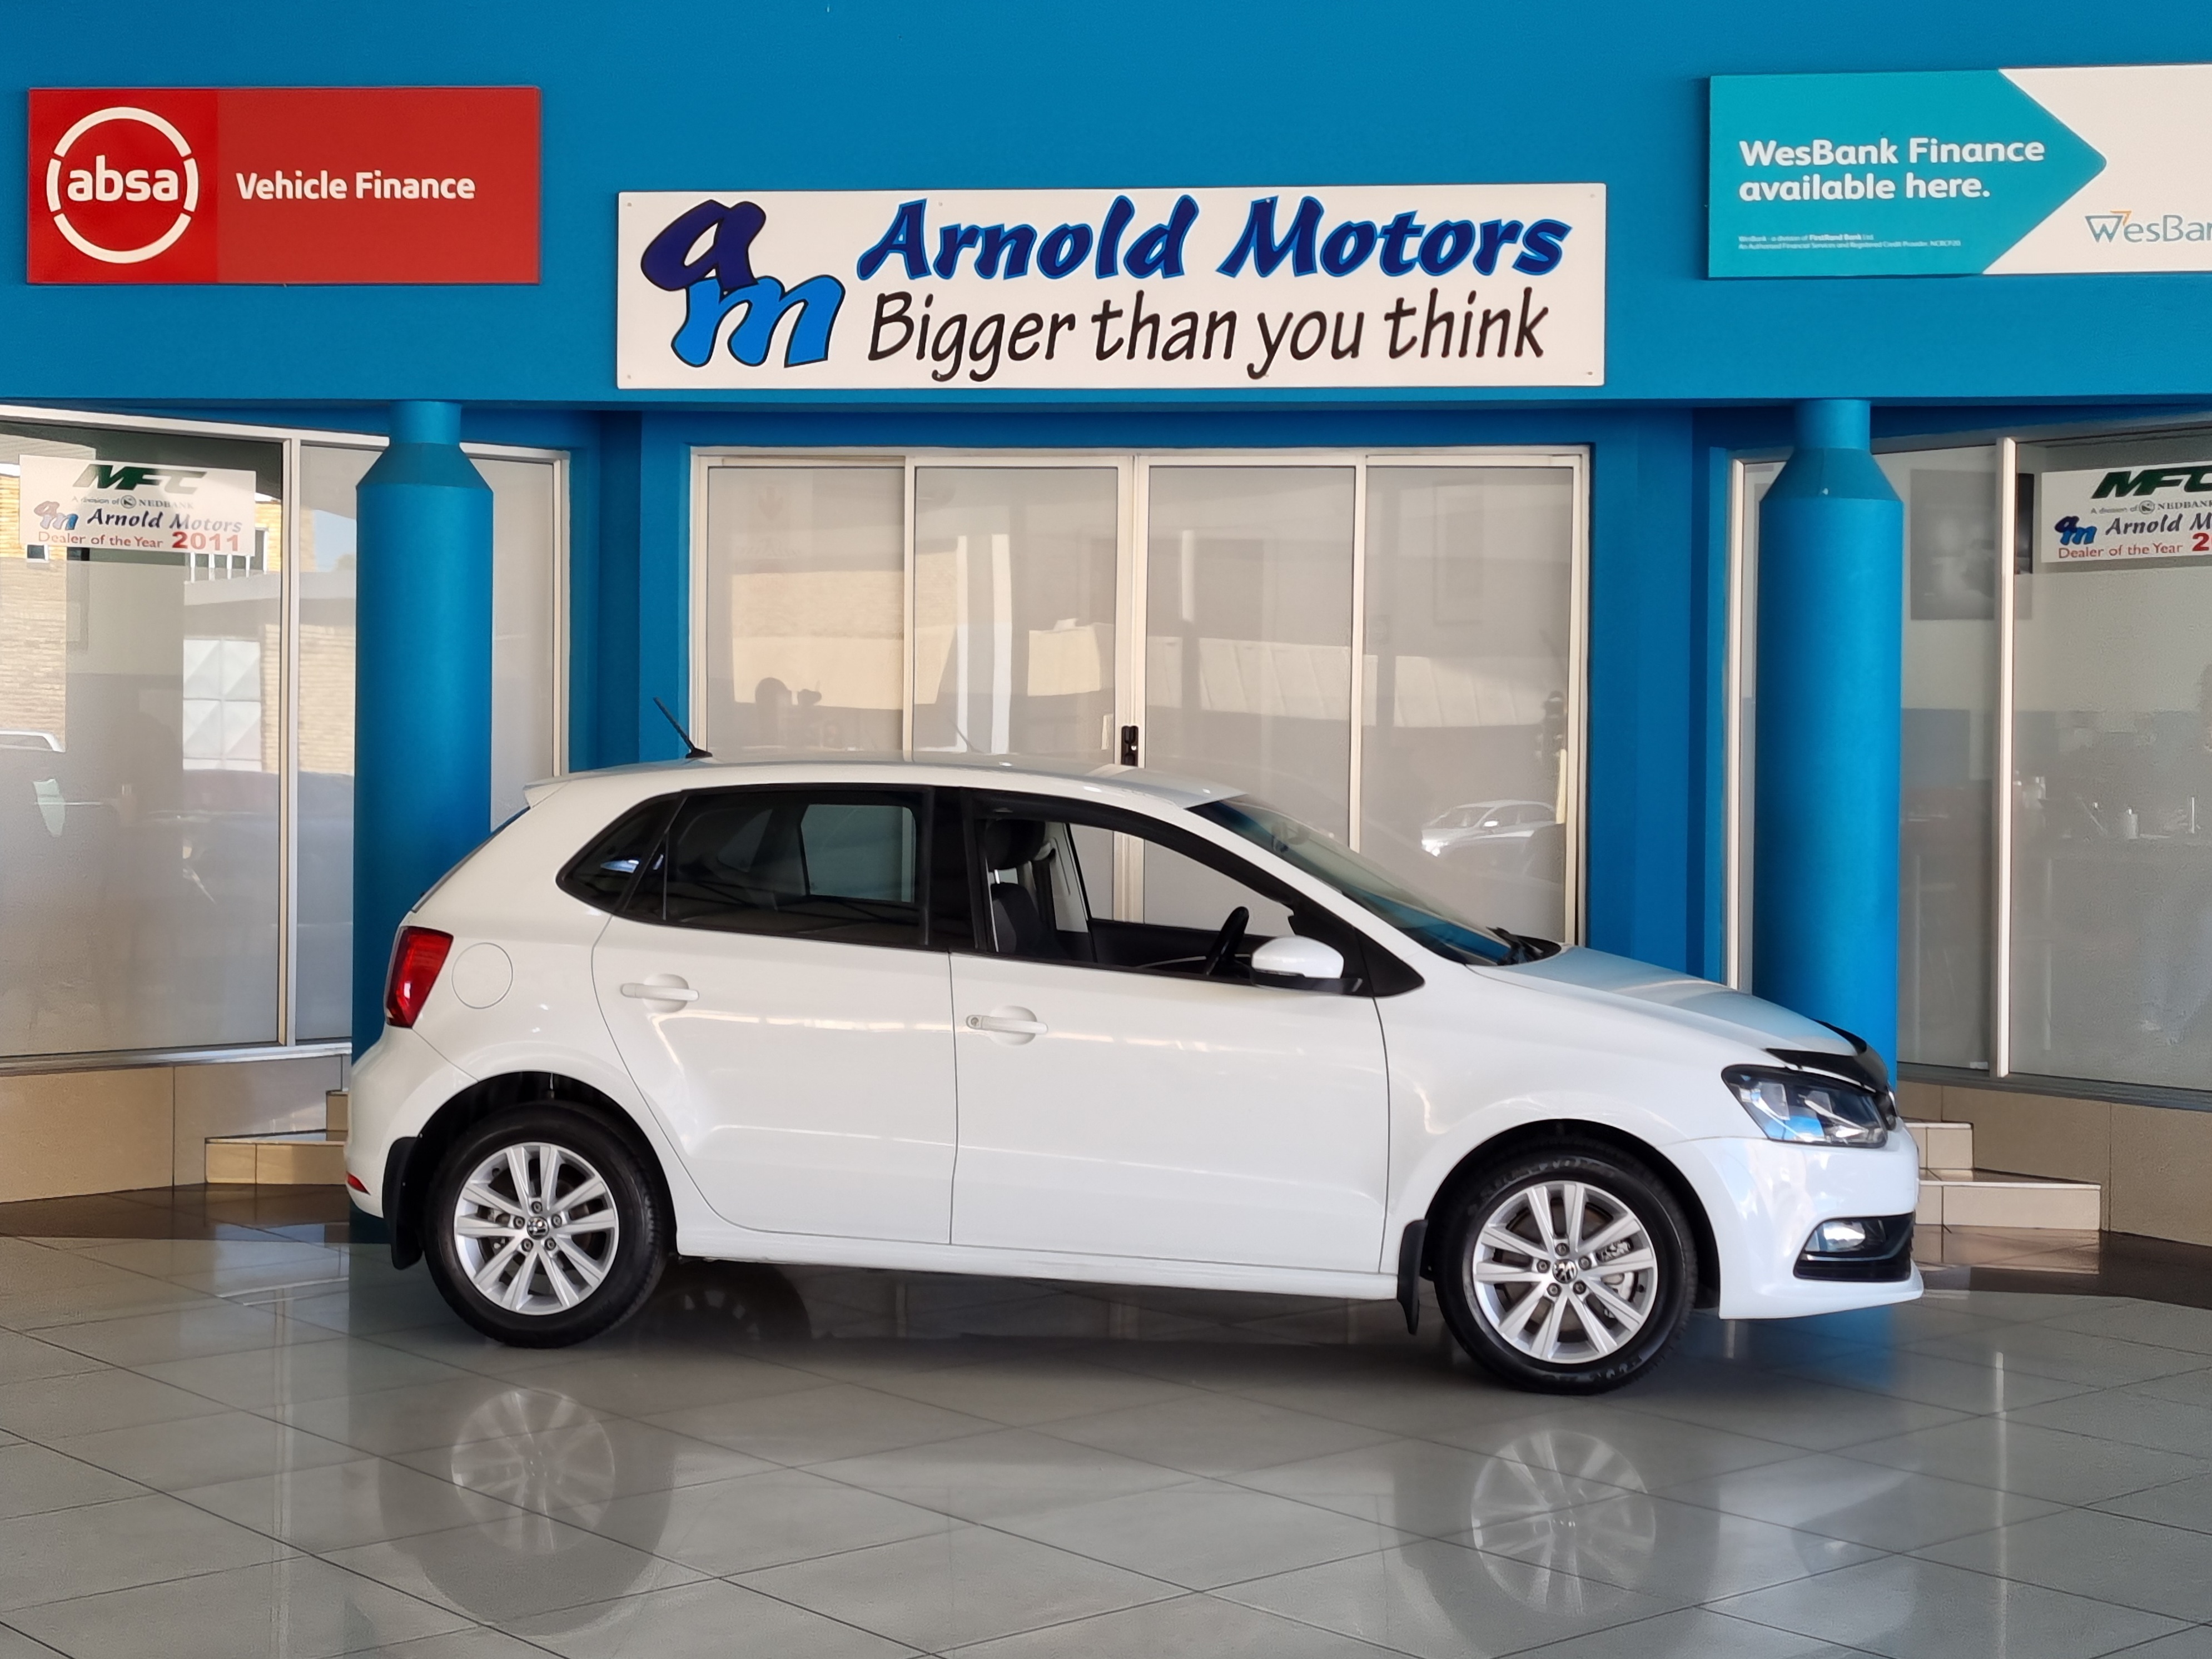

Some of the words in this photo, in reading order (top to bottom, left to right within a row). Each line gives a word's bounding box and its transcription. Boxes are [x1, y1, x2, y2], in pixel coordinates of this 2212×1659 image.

[1739, 137, 1898, 166] WesBank
[1910, 137, 2045, 163] Finance
[67, 155, 179, 201] absa
[236, 170, 347, 199] Vehicle
[356, 170, 476, 199] Finance
[1739, 173, 1896, 201] available
[1906, 172, 1991, 198] here.
[857, 195, 1199, 280] Arnold
[1215, 195, 1573, 278] Motors
[868, 291, 1076, 382] Bigger
[1091, 290, 1237, 361] than
[1247, 310, 1365, 380] you
[1384, 287, 1549, 360] think
[73, 464, 207, 495] MFC
[139, 499, 195, 509] NEDBANK
[87, 508, 163, 528] Arnold
[169, 513, 243, 533] Motors
[2105, 513, 2183, 535] Arnold
[38, 532, 86, 544] Dealer
[91, 534, 106, 545] of
[110, 535, 131, 547] the
[134, 536, 163, 548] Year
[172, 531, 238, 552] 2011
[2059, 547, 2104, 559] Dealer
[2109, 545, 2122, 556] of
[2128, 543, 2150, 555] the
[2153, 543, 2183, 554] Year
